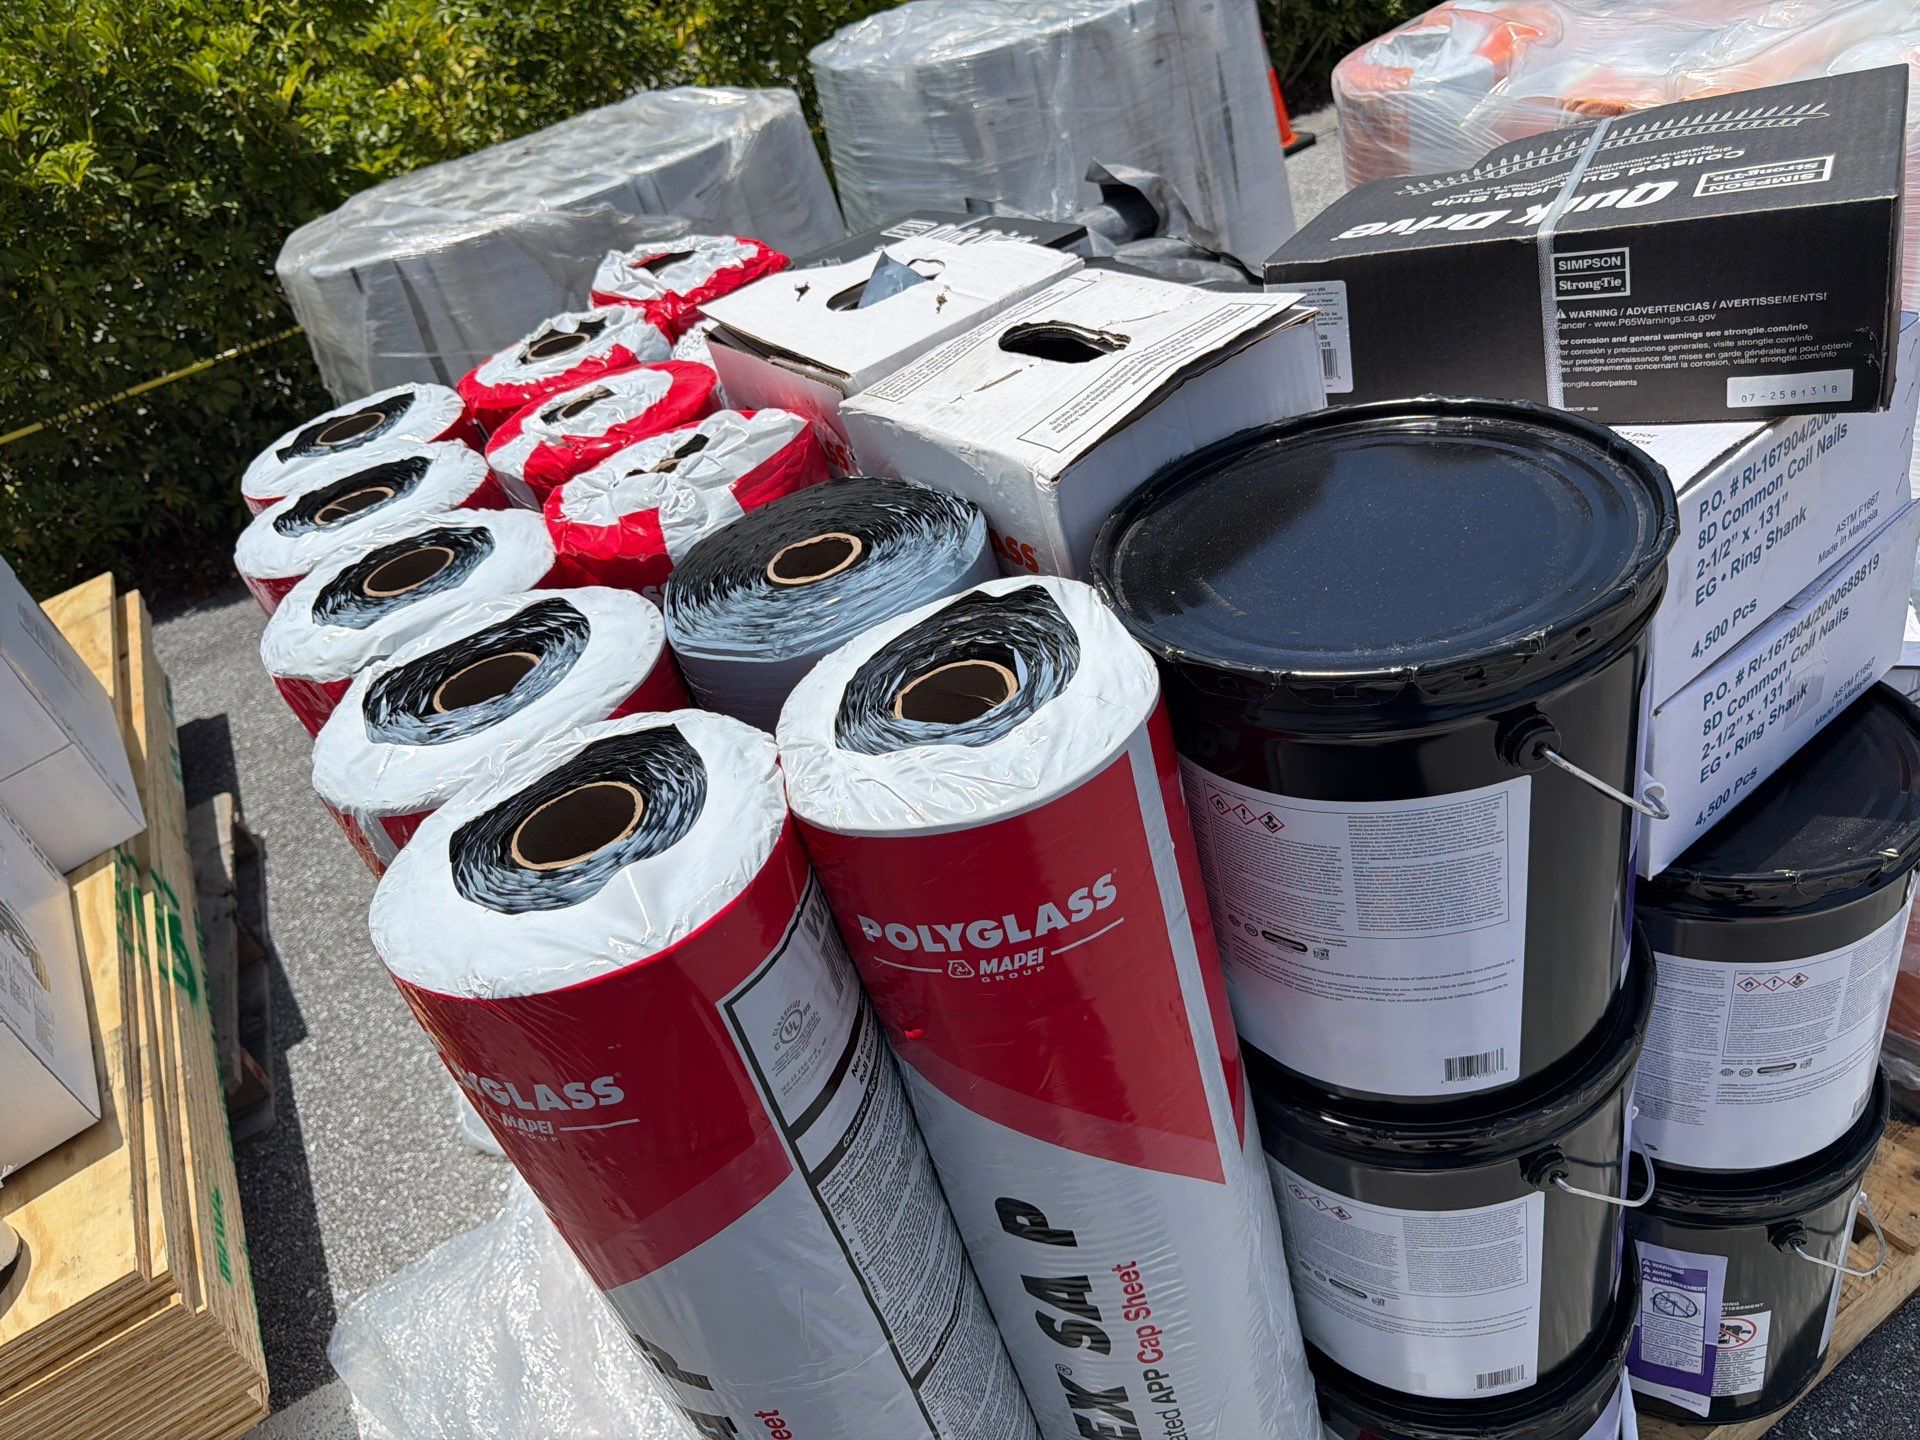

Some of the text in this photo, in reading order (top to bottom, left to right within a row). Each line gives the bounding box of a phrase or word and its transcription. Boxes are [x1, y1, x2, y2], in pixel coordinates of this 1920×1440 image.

[1627, 147, 1746, 176] Collated
[1708, 172, 1816, 192] SIMPSON
[1431, 195, 1489, 207] Strip
[1337, 209, 1512, 239] Drive
[1558, 255, 1621, 271] SIMPSON
[1559, 277, 1622, 291] Strong-Tie
[1568, 308, 1618, 319] WARNING
[1626, 301, 1710, 315] ADVERTENCIAS
[1712, 301, 1717, 310] /
[1719, 292, 1827, 309] AVERTISSEMENTS!
[1570, 336, 1609, 346] corrosion
[1611, 335, 1628, 343] and
[1629, 333, 1661, 344] general
[1663, 331, 1703, 341] warnings
[1705, 330, 1722, 338] see
[1723, 323, 1808, 337] strongtie.com/info
[1594, 313, 1717, 328] www.P65Warnings.ca.gov
[1570, 346, 1606, 356] corrosión
[1607, 347, 1612, 355] y
[1613, 344, 1666, 355] precauciones
[1668, 342, 1710, 353] generales,
[1713, 339, 1735, 348] visite
[1736, 334, 1813, 348] strongtie.com/info
[1575, 357, 1605, 366] prendre
[1606, 355, 1660, 364] connaissance
[1662, 354, 1677, 362] des
[1678, 352, 1703, 361] mises
[1717, 350, 1742, 360] garde
[1744, 346, 1787, 358] générales
[1799, 344, 1819, 354] pout
[1821, 341, 1853, 351] obtenir
[1572, 363, 1633, 373] renseignements
[1634, 361, 1679, 371] concernant
[1680, 360, 1688, 368] la
[1689, 357, 1731, 368] corrosion,
[1732, 356, 1758, 366] visiter
[1760, 351, 1837, 365] strongtie.com/info
[1561, 378, 1638, 389] trongtie.com/patents
[1741, 384, 1838, 403] 07-2581318
[1697, 422, 1849, 551] 8D Common Coil Nails
[1698, 489, 1726, 524] P.O.
[1729, 475, 1740, 498] #
[1835, 490, 1880, 535] ASTM F1667
[1741, 526, 1751, 545] x
[1817, 542, 1839, 565] Made
[1848, 508, 1879, 539] Malaysia
[1695, 505, 1808, 608] EG Ring Shank
[1690, 598, 1758, 659] 4,500 Pcs
[1702, 605, 1850, 737] 8D Common Coil Nails
[1702, 681, 1731, 712] P.O.
[1734, 668, 1745, 688] #
[1832, 681, 1854, 702] ASTM
[1699, 681, 1809, 785] EG Ring Shank
[1745, 709, 1755, 728] x
[1694, 766, 1758, 828] 4,500 Pcs
[856, 872, 1117, 953] POLYGLASS
[979, 946, 1045, 976] MAPEI
[981, 965, 1045, 983] GROUP
[460, 1071, 625, 1112] YGLASS
[501, 1112, 555, 1135] MAPEI
[842, 1093, 869, 1149] General
[994, 1196, 1079, 1248] P
[1651, 1261, 1685, 1275] WARNING
[1111, 1259, 1152, 1322] Sheet
[1651, 1276, 1707, 1292] AVERTISSEMENT
[1020, 1273, 1112, 1356] SA
[1135, 1323, 1164, 1365] Cap
[1142, 1367, 1178, 1404] APP
